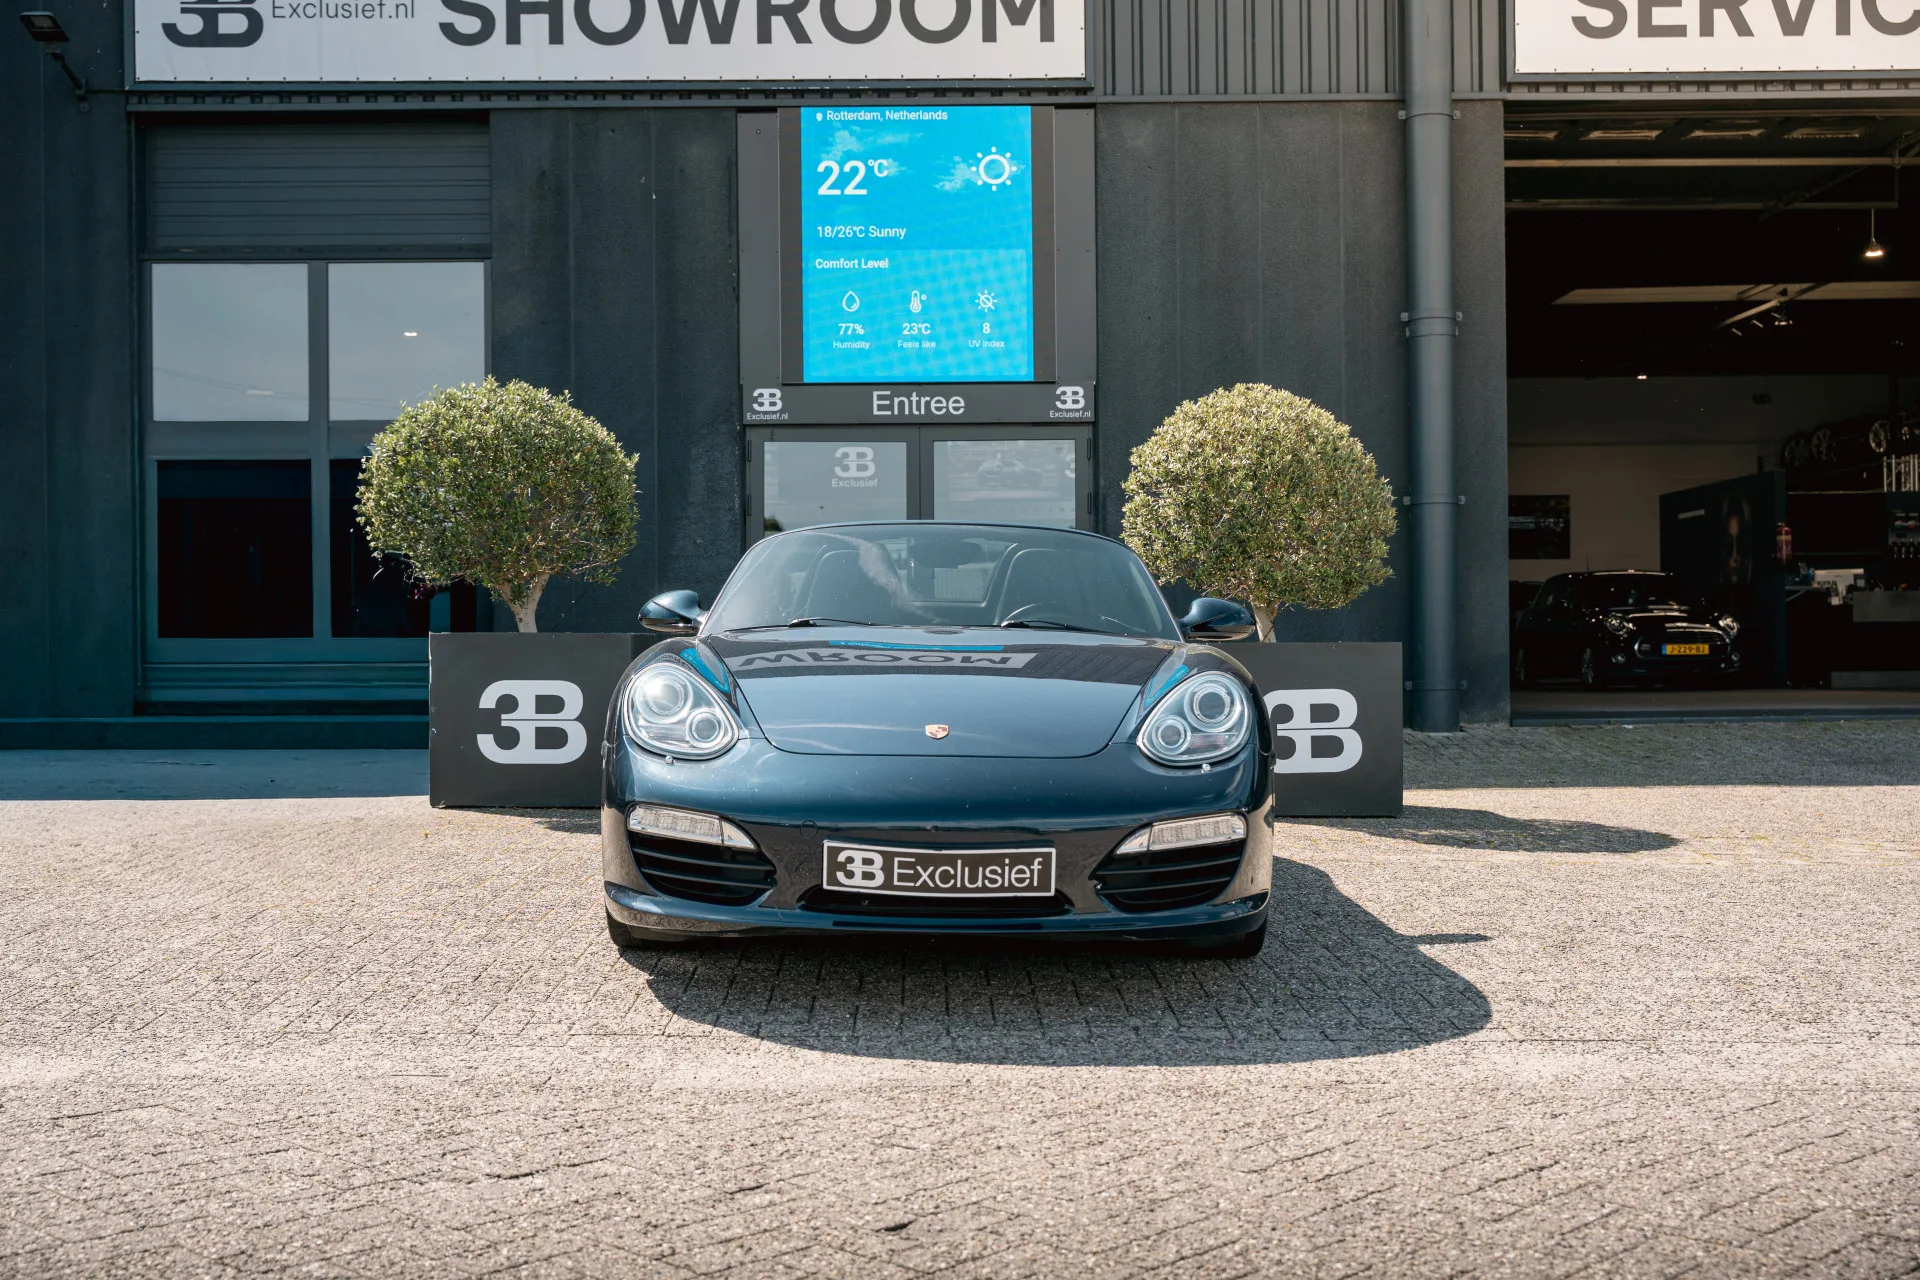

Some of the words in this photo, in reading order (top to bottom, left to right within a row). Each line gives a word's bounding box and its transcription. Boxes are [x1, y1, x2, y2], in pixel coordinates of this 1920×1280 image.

[438, 0, 1056, 47] SHOWROOM
[826, 110, 883, 122] Rotterdam,
[885, 110, 948, 121] Netherlands
[868, 225, 906, 240] Sunny
[815, 257, 859, 269] Comfort
[861, 257, 889, 269] Level
[838, 323, 865, 336] 77%
[982, 322, 991, 335] 8
[833, 340, 870, 350] Humidity
[897, 340, 920, 349] Feels
[921, 340, 937, 349] like
[968, 339, 981, 348] UV
[752, 388, 783, 412] 3B
[872, 390, 965, 416] Entree
[1055, 385, 1085, 410] 3B
[746, 412, 789, 420] Exclusief.nl
[1049, 410, 1091, 418] Exclusief.nl
[834, 446, 876, 478] 3B
[831, 478, 878, 488] Exclusief
[476, 679, 588, 764] 3B
[836, 849, 885, 888] 3B
[893, 857, 1043, 888] Exclusief
